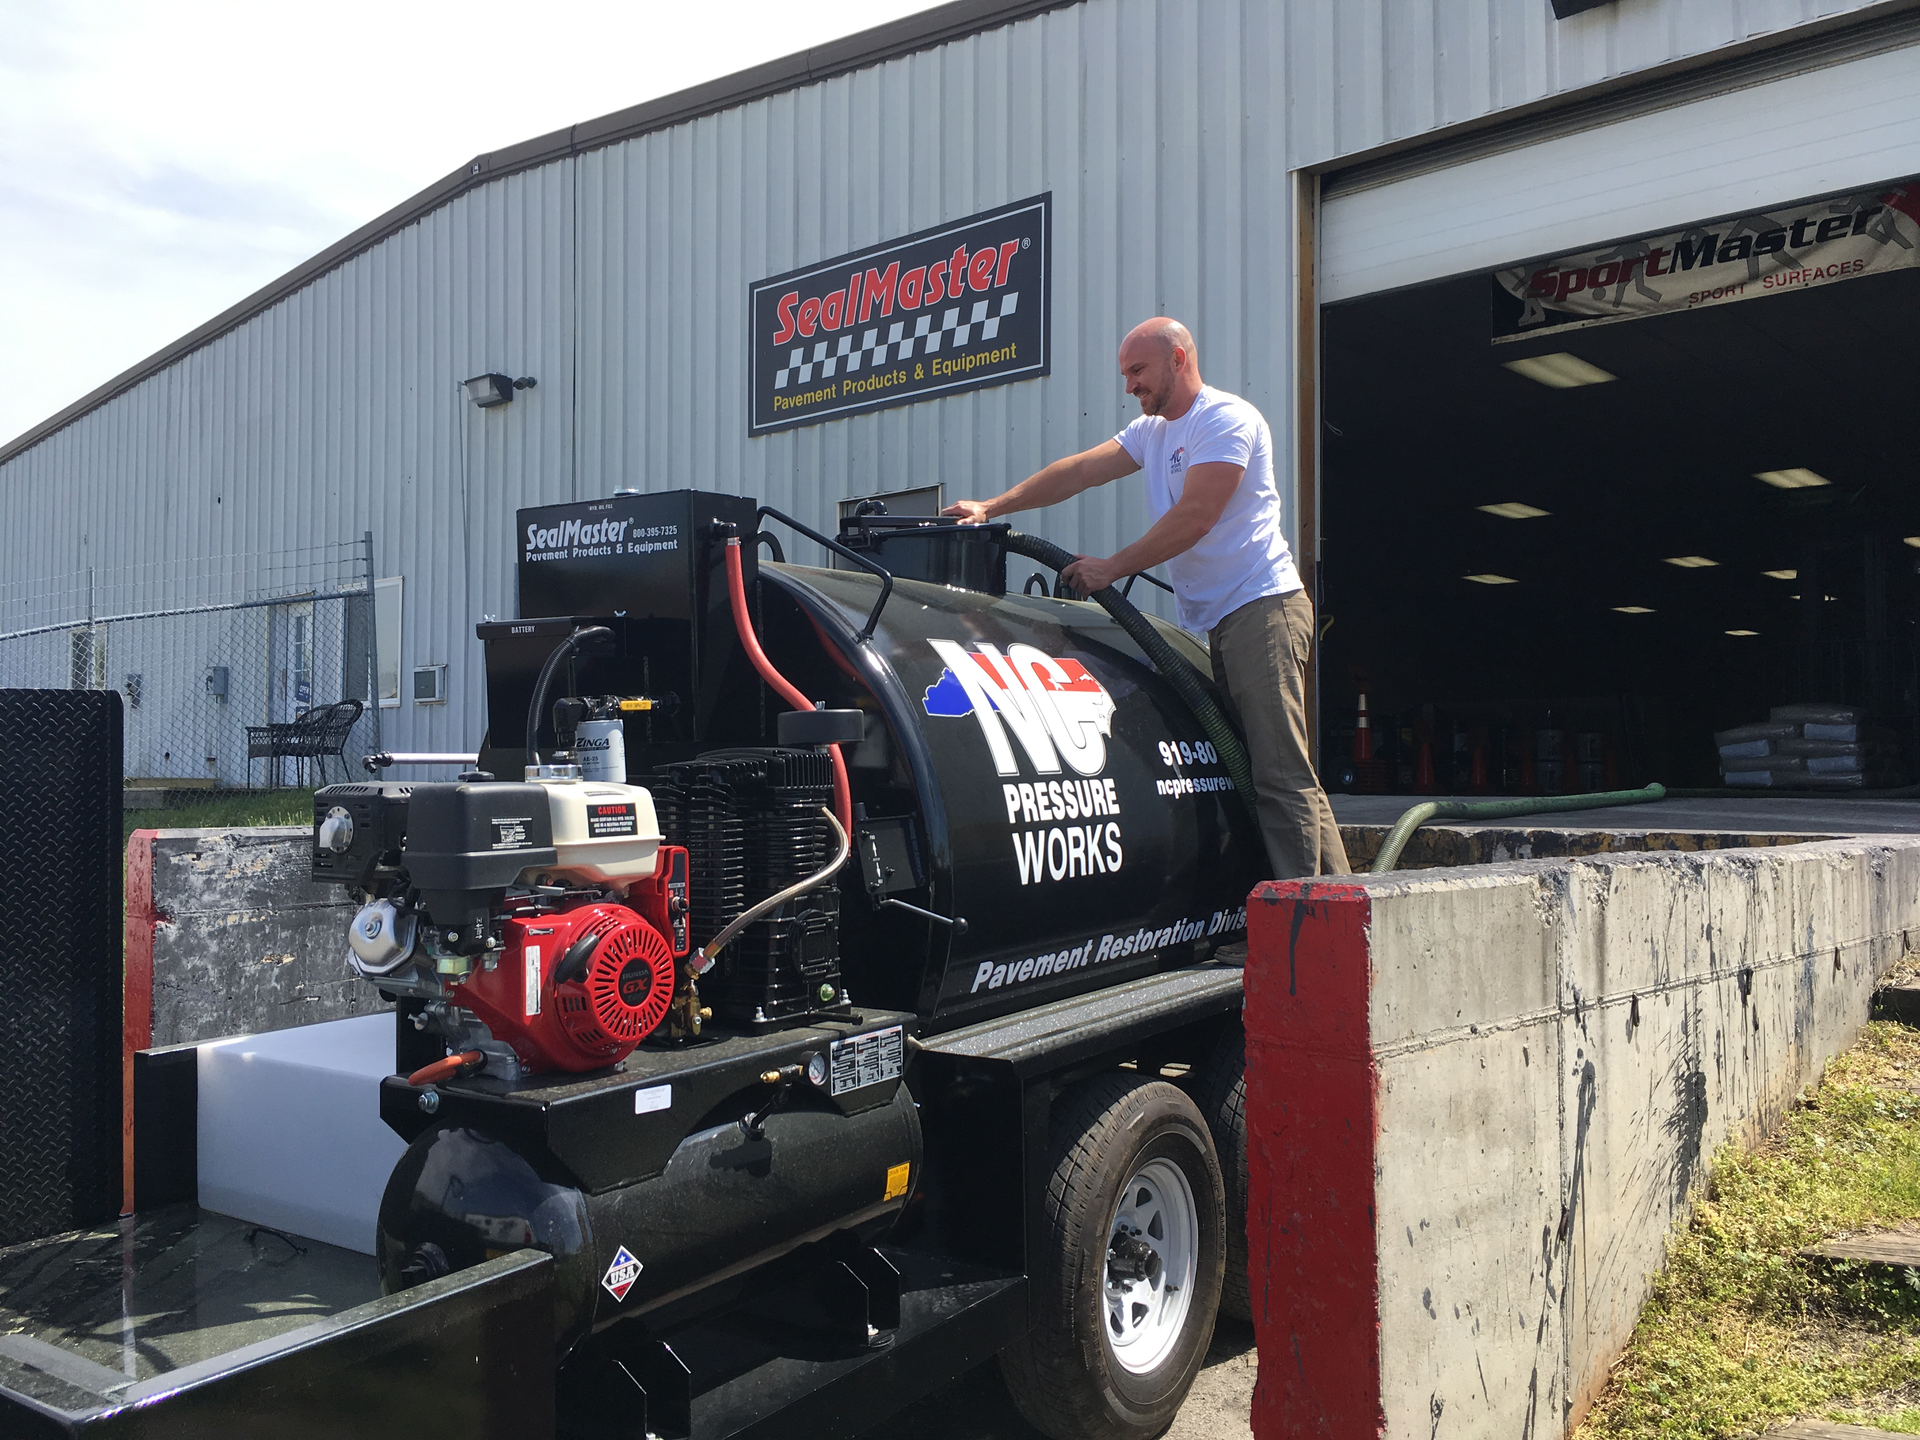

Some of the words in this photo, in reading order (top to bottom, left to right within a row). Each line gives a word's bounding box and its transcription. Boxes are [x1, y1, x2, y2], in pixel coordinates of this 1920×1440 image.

[1526, 206, 1882, 301] SportMaster
[1689, 282, 1748, 304] SPORT
[1763, 259, 1864, 289] SURFACES
[774, 386, 836, 411] Pavement
[843, 369, 906, 397] Products
[914, 363, 924, 379] &
[932, 343, 1017, 377] Equipment
[632, 525, 678, 538] 800-395-7325
[526, 549, 568, 562] Pavement
[572, 546, 611, 558] Products
[616, 544, 623, 553] &
[628, 539, 678, 555] Equipment
[511, 625, 535, 634] BATTERY
[926, 638, 1107, 776] NC
[576, 737, 610, 748] ZINGA
[597, 805, 627, 815] CAUTION
[1003, 778, 1121, 824] PRESSURE
[1012, 821, 1123, 885] WORKS
[970, 938, 1092, 994] Pavement
[1095, 918, 1205, 963] Restoration
[1207, 906, 1247, 936] Divis
[622, 969, 649, 979] HONDA
[622, 977, 648, 995] GX
[610, 1265, 635, 1285] USA
